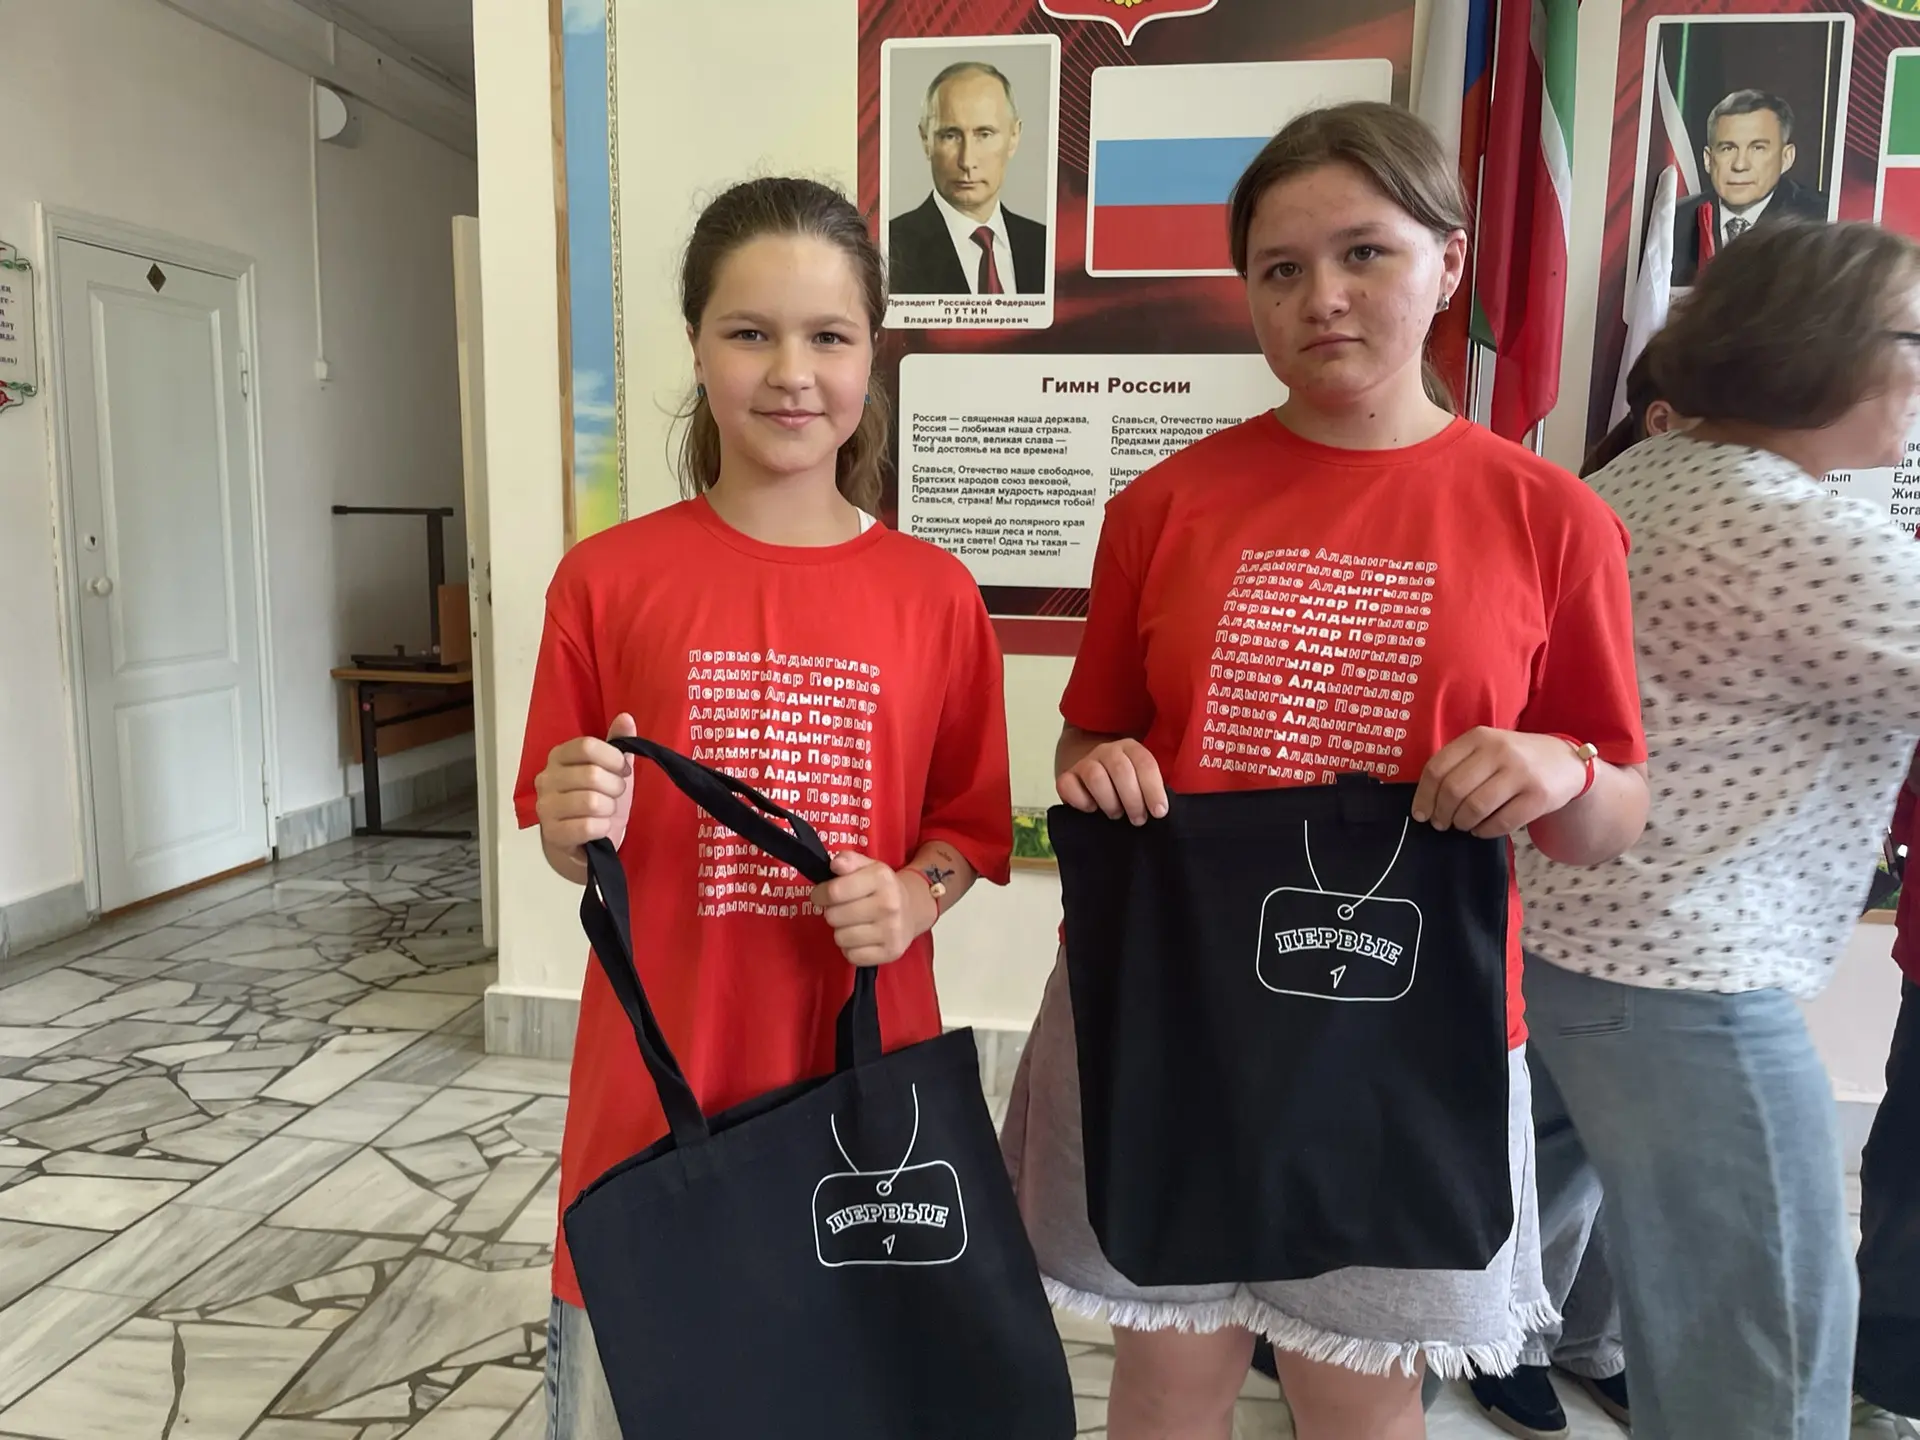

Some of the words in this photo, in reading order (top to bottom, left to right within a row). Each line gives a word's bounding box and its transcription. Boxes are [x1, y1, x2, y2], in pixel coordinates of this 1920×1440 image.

[887, 299, 936, 307] Президент
[938, 299, 993, 307] Российской
[994, 299, 1046, 307] Федерации
[903, 316, 953, 324] Владимир
[956, 316, 1029, 324] Владимирович
[1041, 377, 1100, 394] Гимн
[1107, 377, 1191, 395] России
[912, 413, 947, 423] Россия
[961, 415, 1015, 424] священная
[1044, 416, 1090, 425] держава,
[1112, 415, 1158, 425] Славься,
[1160, 415, 1213, 425] Отечество
[912, 424, 947, 433] Россия
[961, 425, 1006, 434] любимая
[1008, 426, 1034, 434] наша
[1035, 426, 1072, 435] страна.
[1112, 425, 1157, 435] Братских
[1160, 427, 1203, 436] народов
[912, 434, 952, 445] Могучая
[954, 436, 981, 445] воля,
[1111, 436, 1160, 446] Предками
[937, 446, 987, 454] достоянье
[1023, 446, 1068, 456] времена!
[1111, 446, 1156, 456] Славься,
[912, 464, 956, 475] Славься,
[958, 465, 1008, 474] Отечество
[1011, 467, 1035, 475] наше
[1038, 466, 1094, 476] свободное,
[912, 475, 955, 485] Братских
[958, 477, 999, 486] народов
[1001, 477, 1026, 485] союз
[1029, 477, 1071, 487] вековой,
[912, 485, 959, 495] Предками
[961, 487, 995, 496] данная
[998, 488, 1044, 497] мудрость
[1046, 487, 1096, 496] народная!
[912, 495, 955, 505] Славься,
[957, 496, 993, 505] страна!
[996, 497, 1012, 505] Мы
[1014, 497, 1061, 507] гордимся
[1063, 497, 1095, 506] тобой!
[911, 515, 924, 524] От
[963, 516, 992, 526] морей
[994, 518, 1007, 526] до
[1009, 519, 1060, 528] полярного
[1063, 519, 1085, 527] края
[911, 525, 972, 535] Раскинулись
[975, 527, 1000, 535] наши
[1035, 528, 1062, 536] поля.
[967, 537, 996, 545] свете!
[999, 537, 1023, 546] Одна
[1041, 539, 1068, 547] такая
[960, 546, 990, 555] Богом
[992, 547, 1027, 557] родная
[1029, 547, 1061, 556] земля!
[1241, 548, 1311, 560] Первые
[1315, 548, 1438, 573] Алдынгылар
[1236, 561, 1354, 581] Алдынгылар
[1360, 569, 1436, 587] Первые
[1233, 574, 1304, 589] Первые
[1309, 579, 1433, 602] Алдынгылар
[1227, 587, 1348, 610] Алдынгылар
[1355, 599, 1432, 616] Первые
[1223, 600, 1296, 618] Первые
[1301, 608, 1429, 632] Алдынгылар
[1218, 614, 1342, 641] Алдынгылар
[1348, 629, 1426, 648] Первые
[1215, 630, 1289, 650] Первые
[1294, 639, 1423, 667] Алдынгылар
[689, 649, 761, 664] Первые
[765, 649, 881, 678] Алдынгылар
[1212, 647, 1335, 677] Алдынгылар
[1341, 662, 1419, 685] Первые
[688, 667, 804, 687] Алдынгылар
[810, 672, 881, 695] Первые
[1210, 664, 1283, 686] Первые
[1288, 674, 1414, 705] Алдынгылар
[688, 685, 761, 701] Первые
[765, 686, 877, 715] Алдынгылар
[1208, 682, 1328, 712] Алдынгылар
[1334, 698, 1411, 721] Первые
[689, 705, 802, 726] Алдынгылар
[1206, 700, 1278, 722] Первые
[1282, 710, 1407, 741] Алдынгылар
[691, 725, 760, 741] Первые
[1203, 719, 1322, 748] Алдынгылар
[1328, 734, 1403, 757] Первые
[692, 746, 802, 765] Алдынгылар
[808, 749, 872, 771] Первые
[1202, 736, 1272, 758] Первые
[1276, 746, 1400, 776] Алдынгылар
[764, 765, 872, 791] Алдынгылар
[1199, 754, 1316, 784] Алдынгылар
[807, 788, 872, 809] Первые
[815, 828, 868, 847] ервые
[698, 843, 758, 860] Первые
[698, 863, 798, 880] Алдынгылар
[698, 882, 757, 899] Первые
[697, 901, 798, 918] Алдынгылар
[1275, 927, 1403, 966] ПЕРВЫЕ
[826, 1203, 949, 1234] ПЕРВЫЕ
